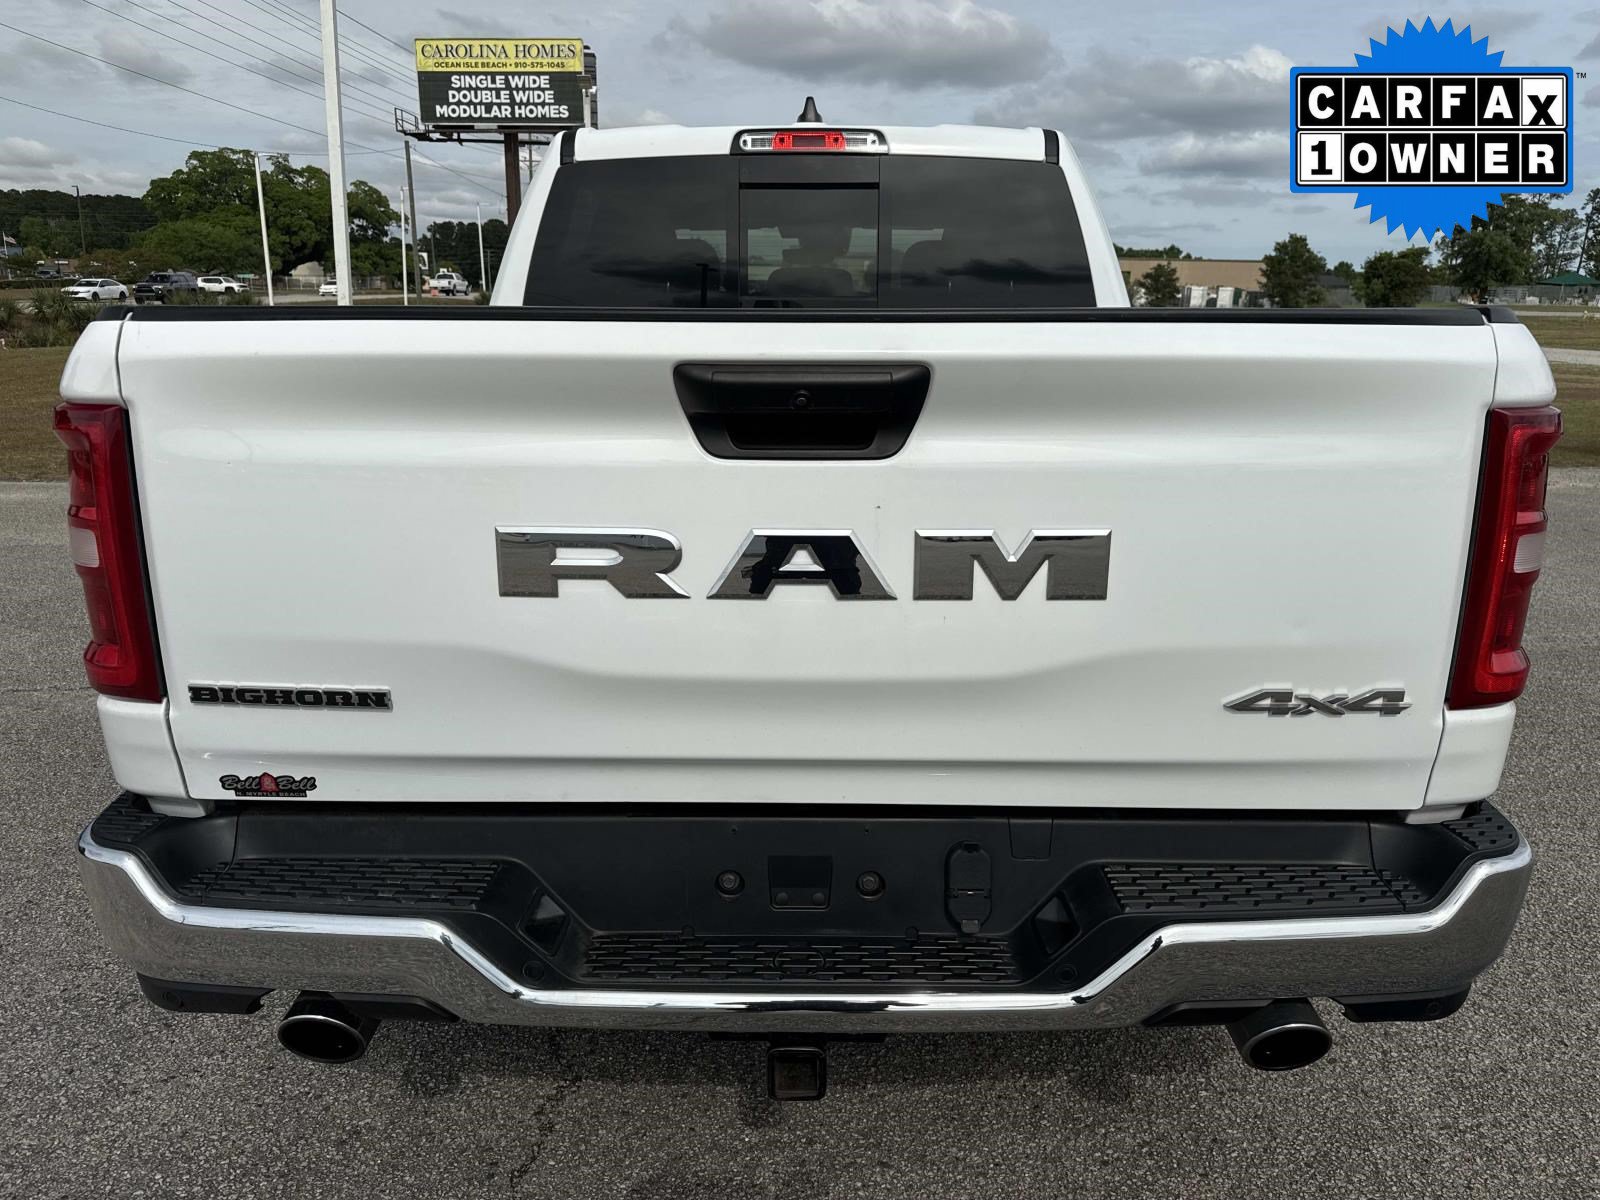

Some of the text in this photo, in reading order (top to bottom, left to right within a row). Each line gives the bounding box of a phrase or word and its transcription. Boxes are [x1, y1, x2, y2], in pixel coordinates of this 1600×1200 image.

[421, 44, 576, 58] CAROLINA HOMES
[451, 75, 550, 88] SINGLE WIDE
[448, 90, 554, 103] DOUBLE WIDE
[436, 105, 569, 118] MODULAR HOMES
[495, 525, 1112, 601] RAM
[188, 684, 392, 710] BIGHORN
[220, 776, 260, 790] Bell
[276, 777, 316, 790] Bell
